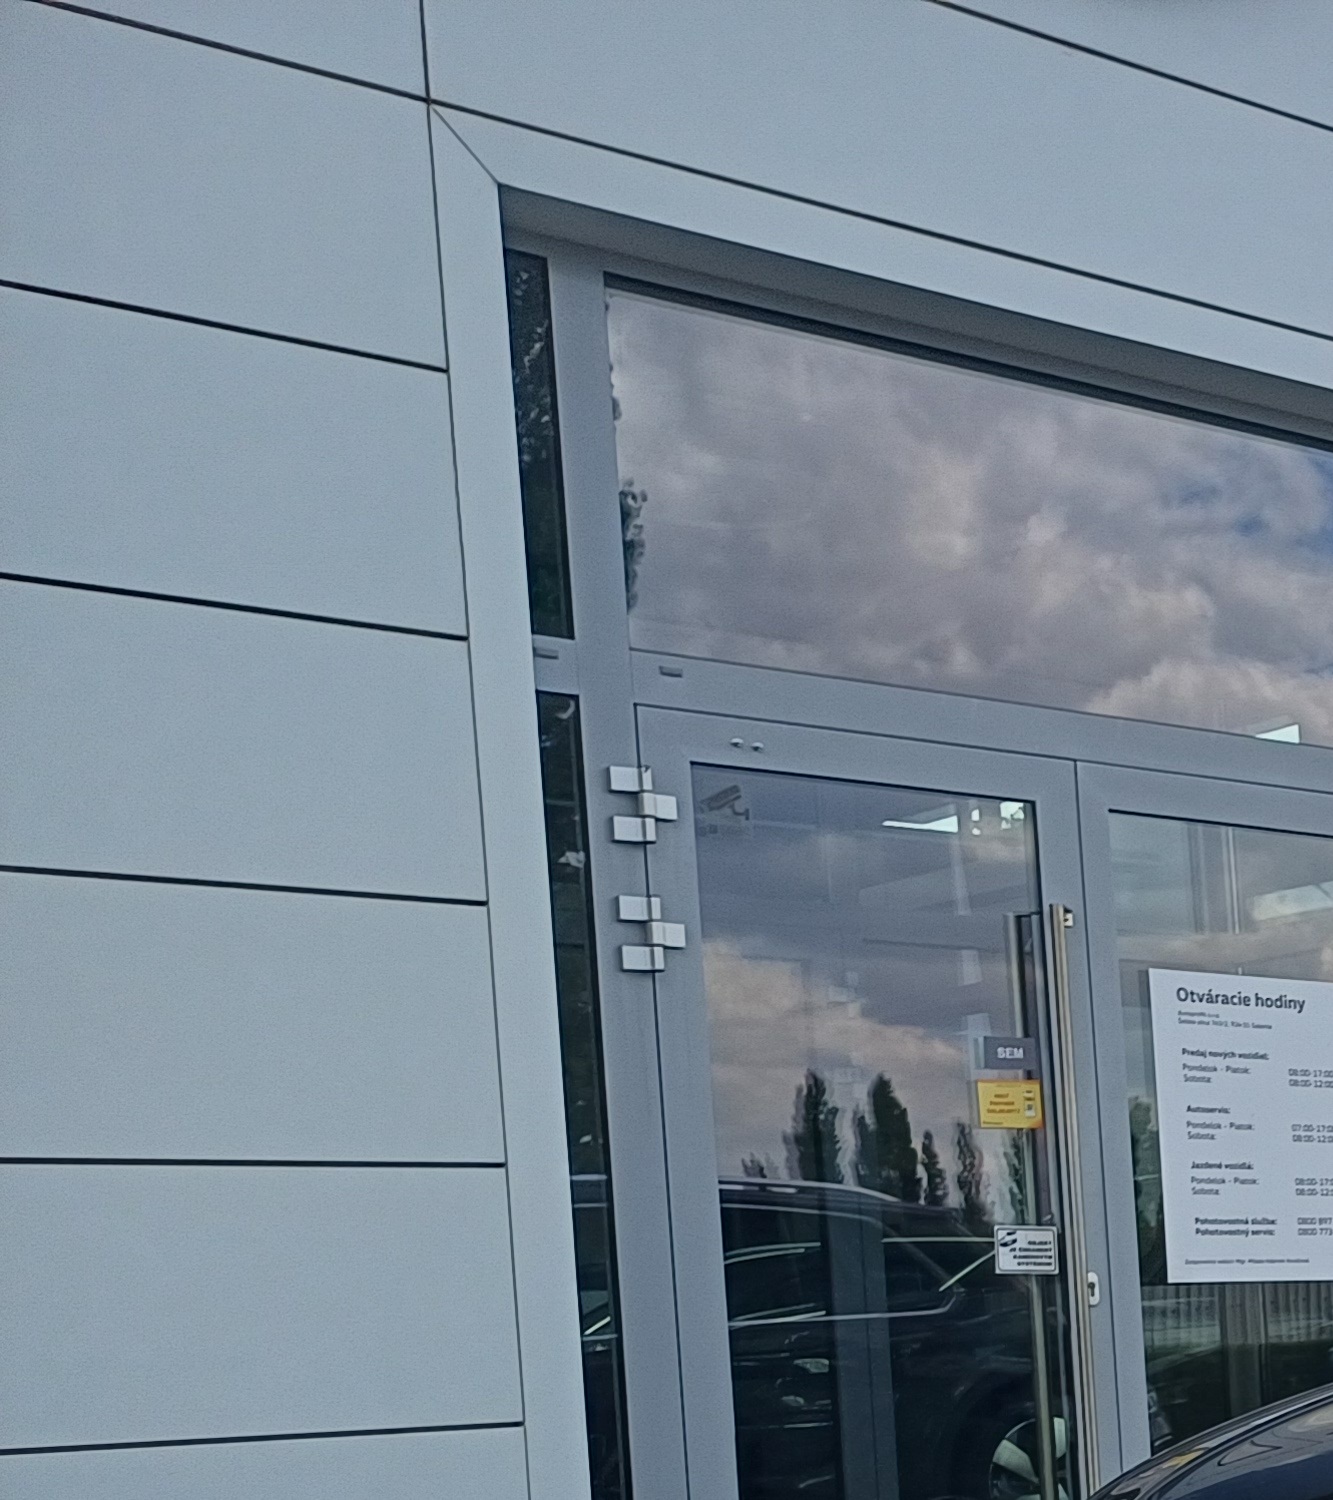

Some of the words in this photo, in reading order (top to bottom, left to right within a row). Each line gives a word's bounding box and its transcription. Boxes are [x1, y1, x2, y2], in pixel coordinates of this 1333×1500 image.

[1176, 987, 1251, 1006] Otváracie
[1255, 993, 1305, 1013] hodiny
[997, 1047, 1023, 1058] SEM
